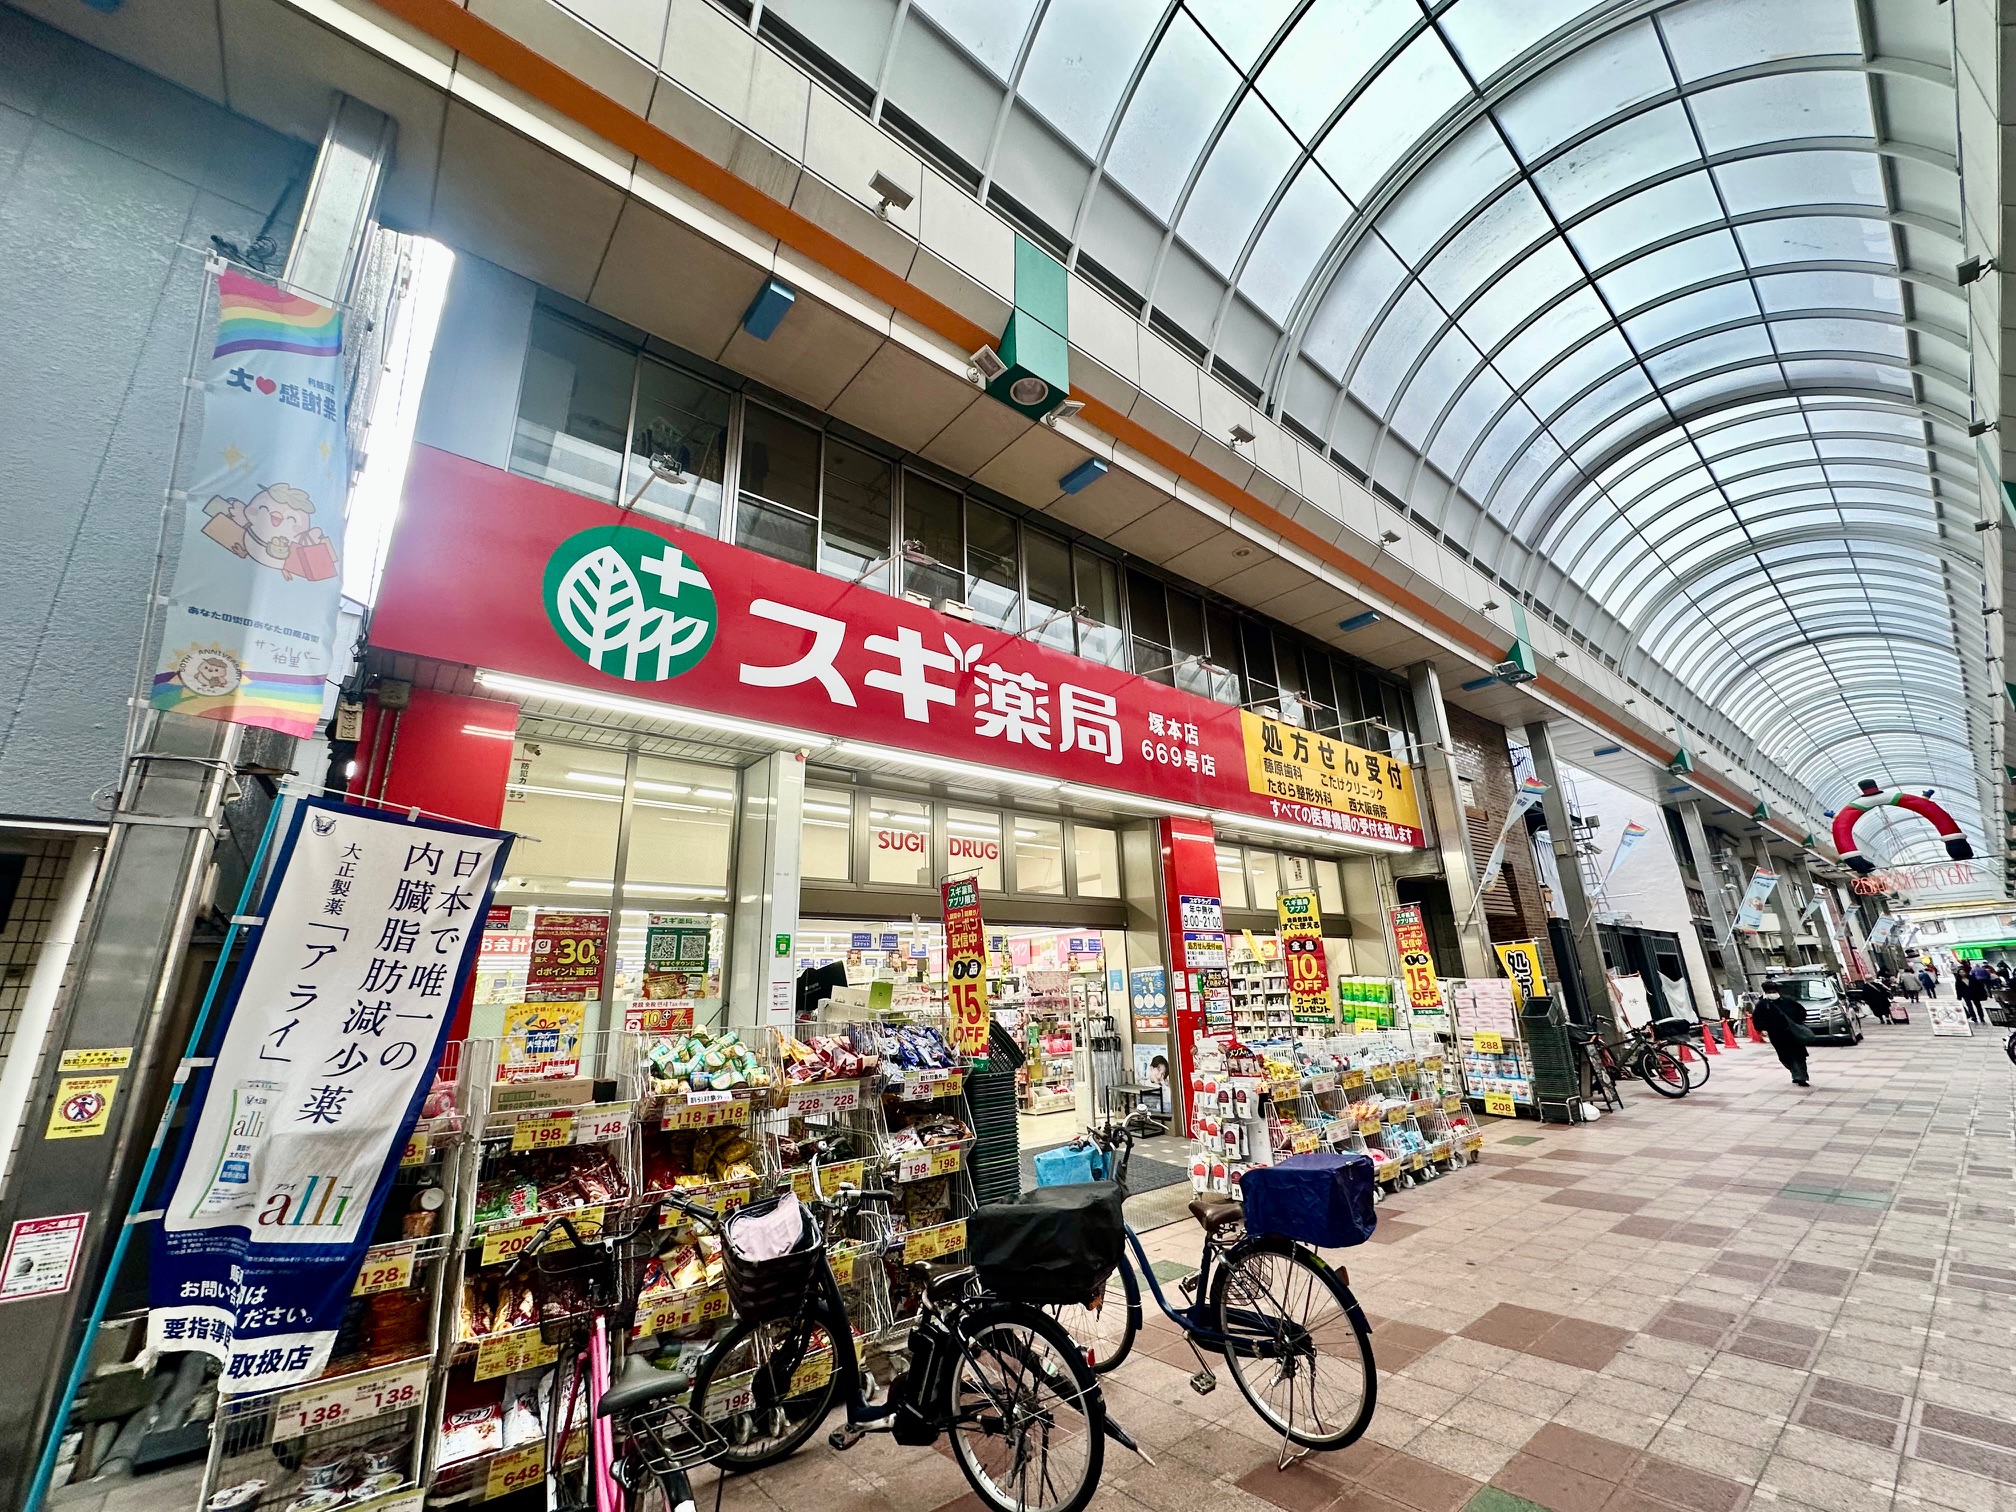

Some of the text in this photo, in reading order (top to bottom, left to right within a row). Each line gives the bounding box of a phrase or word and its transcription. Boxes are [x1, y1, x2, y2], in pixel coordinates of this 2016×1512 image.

[739, 598, 1123, 765] スギ薬局
[1148, 711, 1200, 746] 塚本店
[1141, 739, 1216, 778] 669号店
[1261, 721, 1403, 791] 処方せん受付
[1263, 758, 1384, 800] 藤原歯科 こたけクリニック
[1266, 778, 1388, 820] たむら整形外科 西大阪病院
[1269, 800, 1413, 844] すべての医療機関の受付を致します
[878, 830, 924, 853] SUGI
[949, 838, 999, 860] DRUG
[323, 842, 362, 916] 大正製薬
[1189, 905, 1214, 915] 年中無休
[1282, 921, 1320, 930] すぐに使える
[952, 934, 978, 948] 配信中
[378, 849, 484, 1072] 日本で唯一の
[295, 841, 444, 1125] 内臓脂肪減少薬
[1293, 980, 1322, 990] OFF
[1412, 991, 1436, 1000] OFF
[1294, 1004, 1331, 1014] プレゼント
[1296, 996, 1326, 1004] クーポン
[954, 1026, 984, 1043] OFF
[1480, 1041, 1500, 1050] 288
[1492, 1103, 1512, 1112] 208
[233, 1110, 264, 1138] alli
[258, 1176, 353, 1226] alli
[226, 1345, 314, 1380] 取扱店
[503, 1464, 541, 1487] 648
